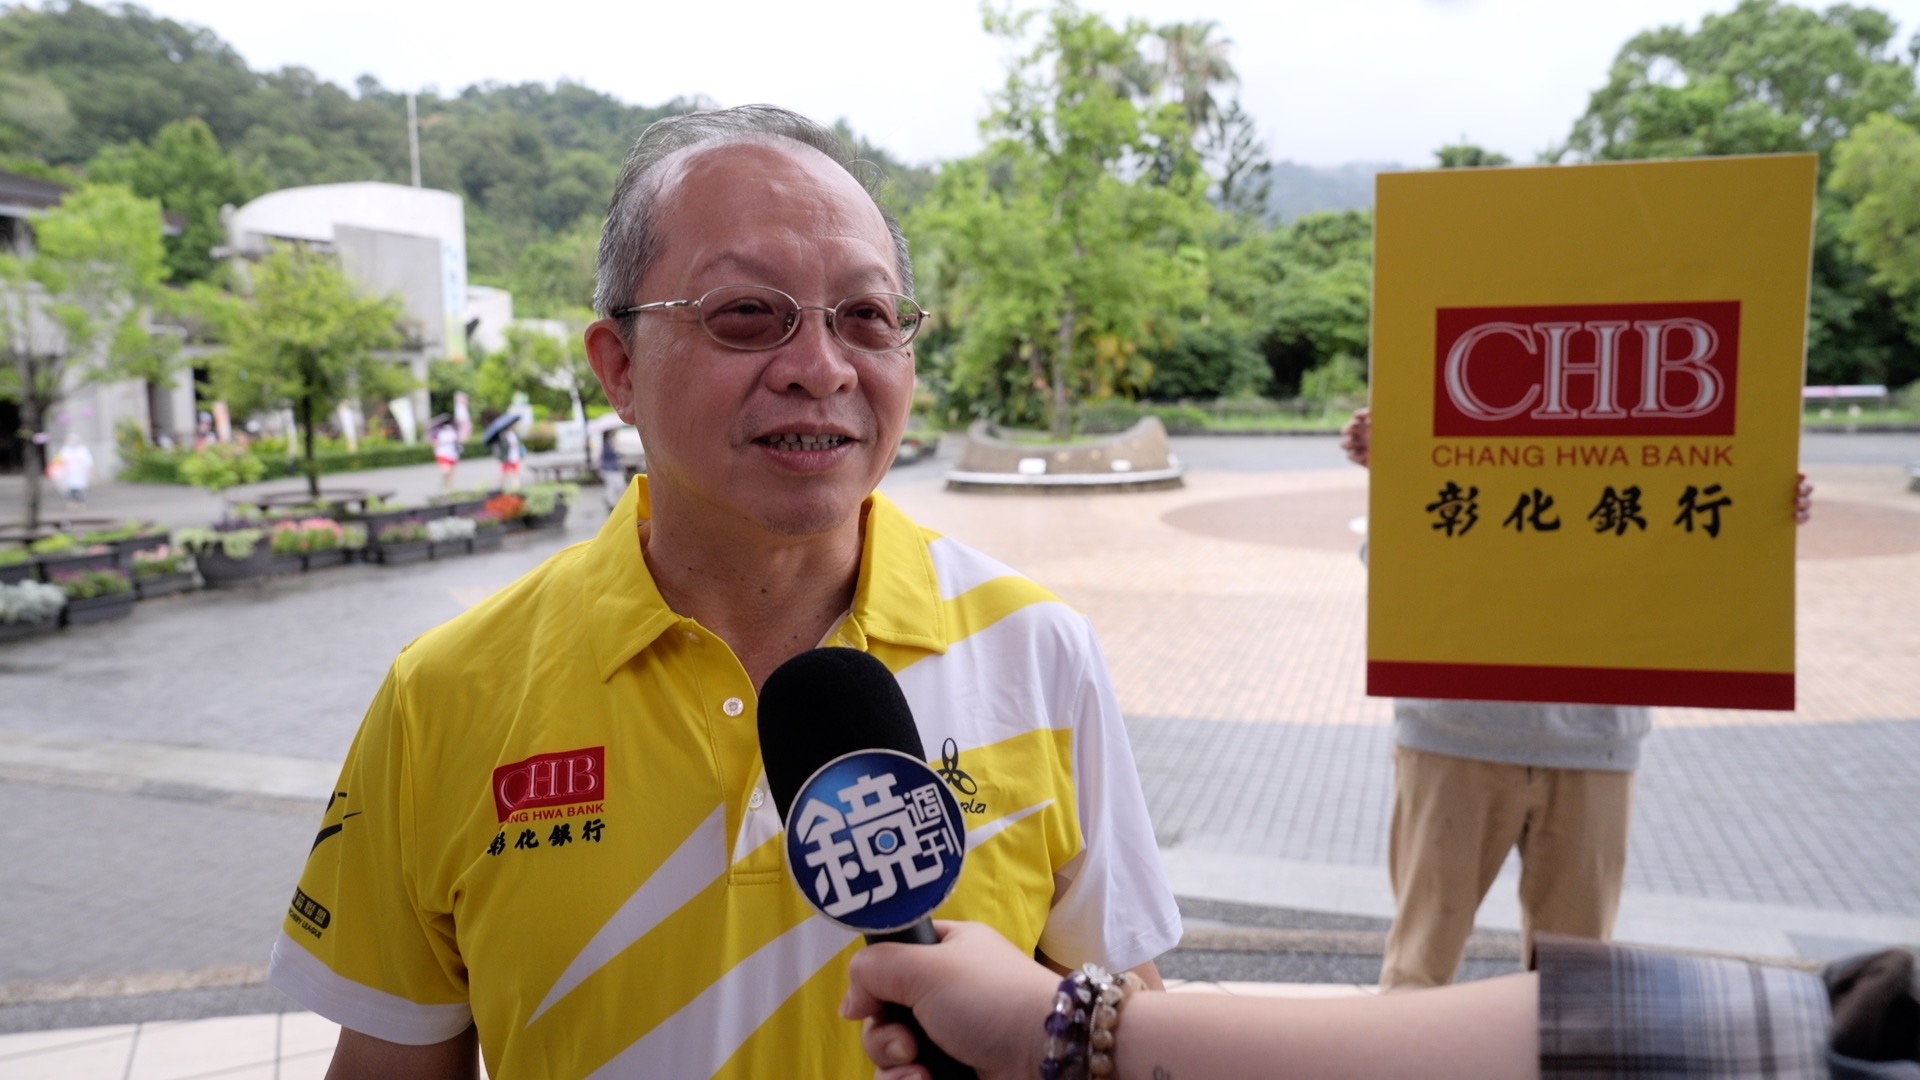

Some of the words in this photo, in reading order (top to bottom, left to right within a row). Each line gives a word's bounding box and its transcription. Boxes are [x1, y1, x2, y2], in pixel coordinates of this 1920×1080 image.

[1444, 317, 1724, 421] CHB
[1431, 445, 1545, 468] CHANG
[1556, 445, 1630, 468] HWA
[1641, 445, 1734, 468] BANK
[1426, 481, 1733, 538] 彰化銀行
[500, 754, 599, 809] CHB
[533, 809, 563, 821] HWA
[567, 803, 604, 817] BANK
[487, 818, 606, 856] 彰化銀行
